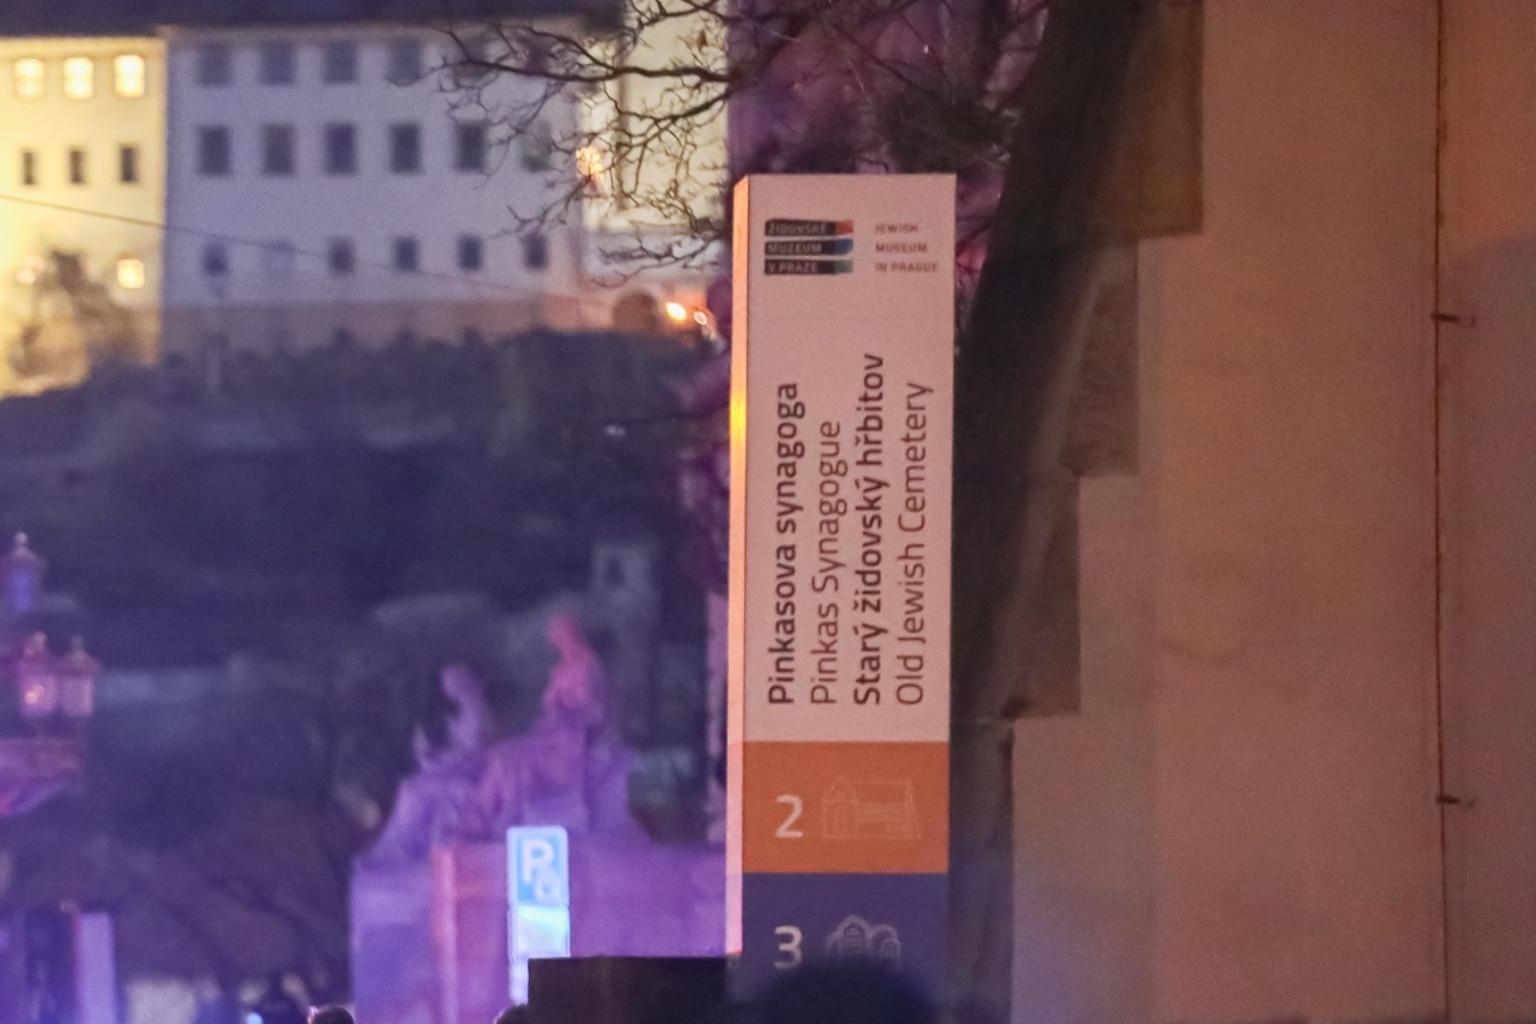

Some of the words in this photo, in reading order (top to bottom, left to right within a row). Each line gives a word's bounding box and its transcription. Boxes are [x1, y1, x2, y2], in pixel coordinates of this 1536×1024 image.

[767, 242, 822, 254] MUZEUM
[875, 223, 918, 235] JEWISH
[875, 242, 928, 253] MUSEUM
[854, 353, 883, 466] hřbitov
[776, 382, 806, 534] synagoga
[898, 382, 935, 532] Cemetery
[811, 421, 848, 593] Synagogue
[853, 476, 890, 613] židovský
[768, 544, 796, 704] Pinkasova
[896, 543, 926, 644] Jewish
[810, 603, 839, 705] Pinkas
[853, 623, 889, 706] Starý
[895, 654, 924, 705] Old
[521, 839, 555, 884] P
[775, 794, 804, 838] 2
[774, 925, 803, 969] 3
